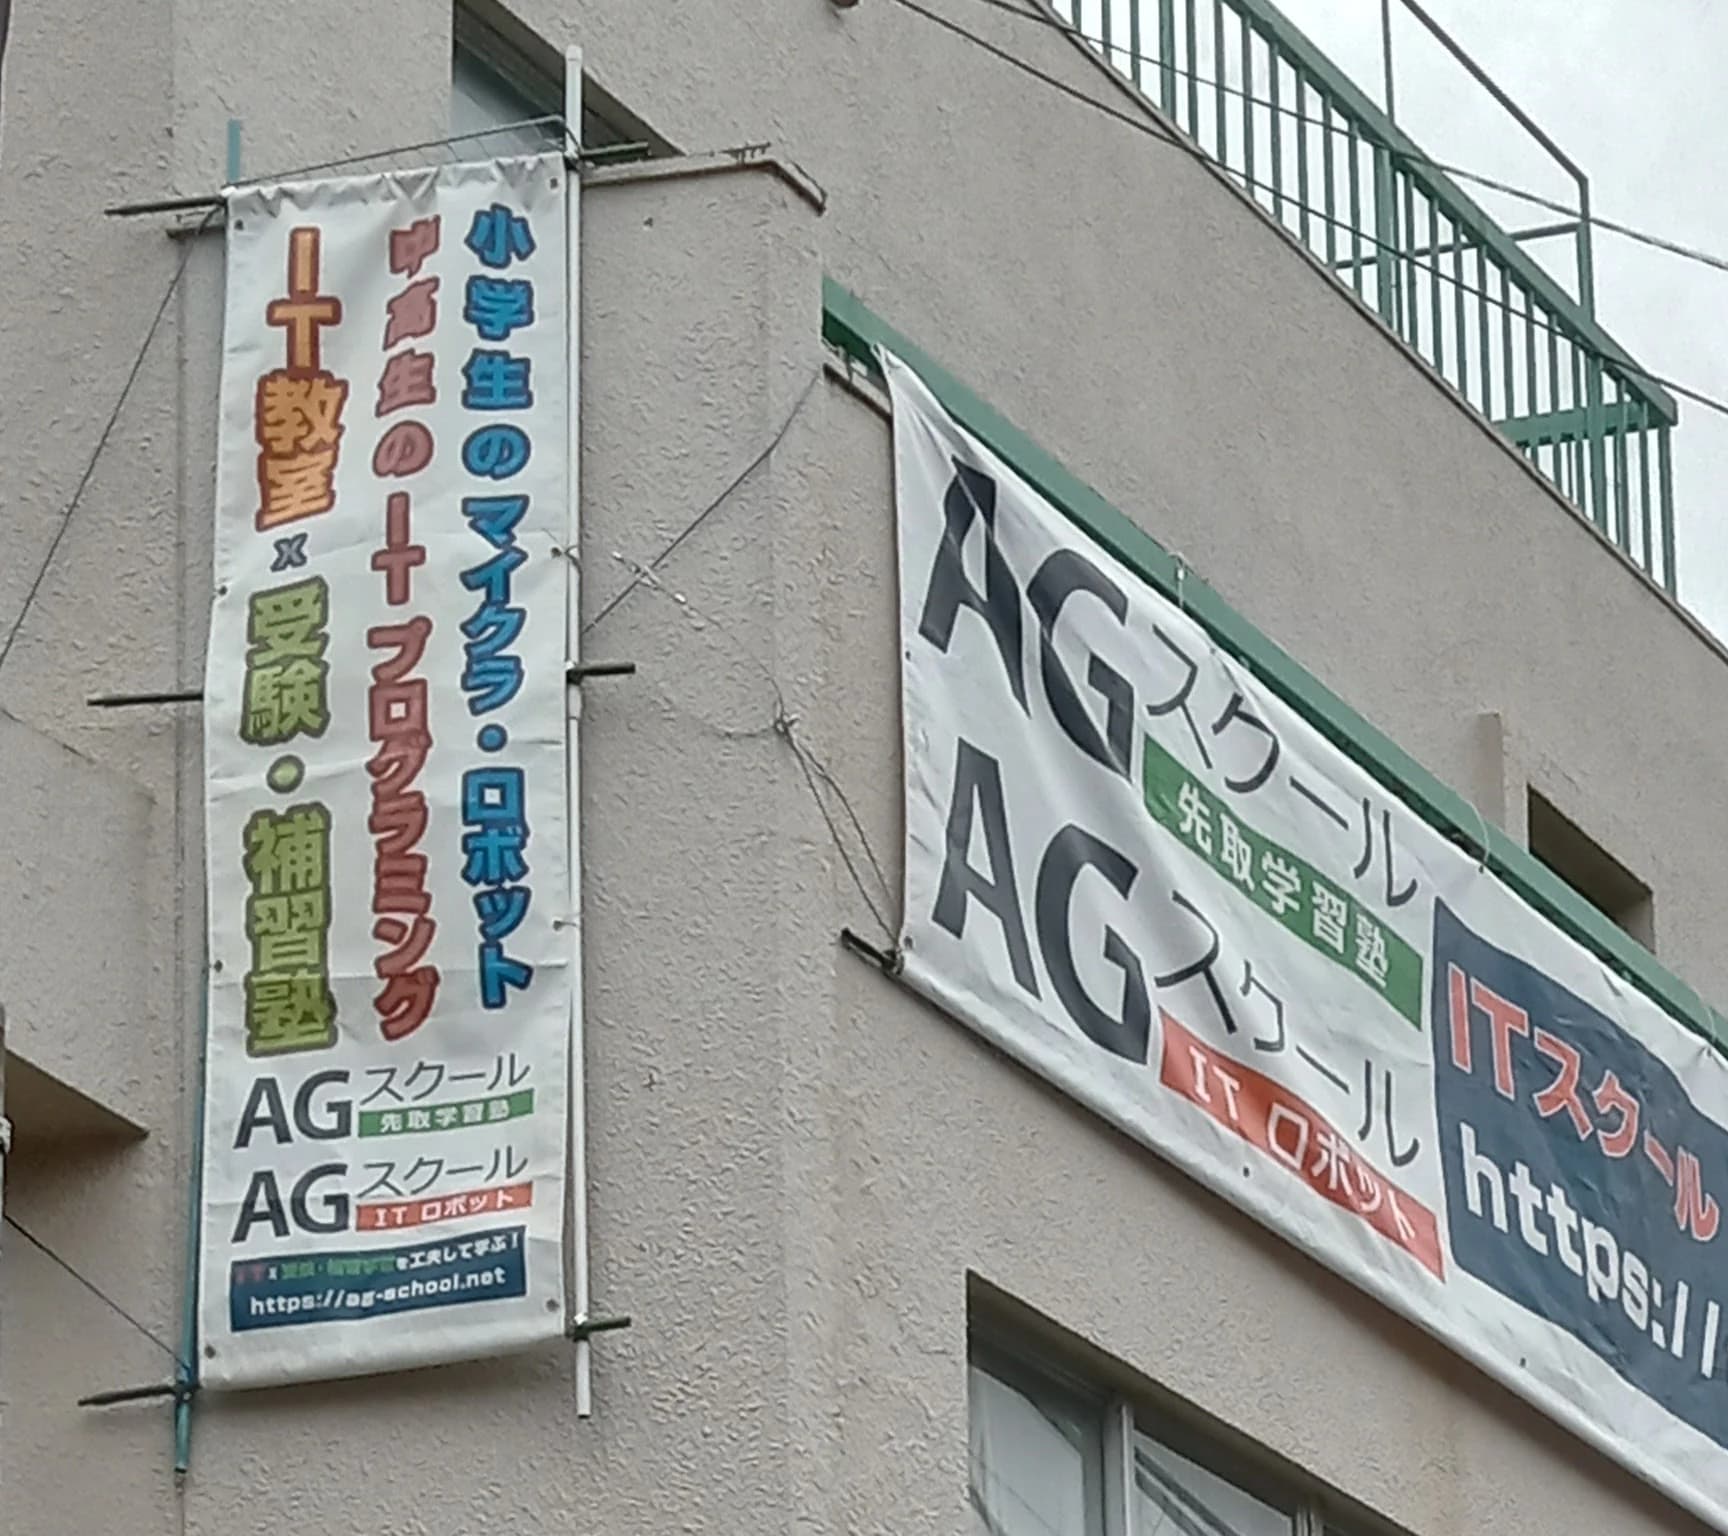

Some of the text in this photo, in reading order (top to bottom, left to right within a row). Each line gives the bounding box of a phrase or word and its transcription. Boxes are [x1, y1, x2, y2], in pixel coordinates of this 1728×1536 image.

[460, 202, 536, 1008] 小学生のマイクラ・ロボット
[919, 454, 1417, 907] AG スクール
[932, 737, 1418, 1167] AG スクール
[1176, 782, 1391, 995] 先取学習塾
[231, 1145, 529, 1244] AG スクール
[233, 1052, 531, 1150] AG スクール
[380, 1099, 511, 1132] 先取学習塾
[1187, 1046, 1413, 1241] IT ロボット
[1446, 961, 1720, 1242] ITスクール
[250, 1268, 506, 1316] https://ag-school.net
[374, 1190, 514, 1228] IT ロボット
